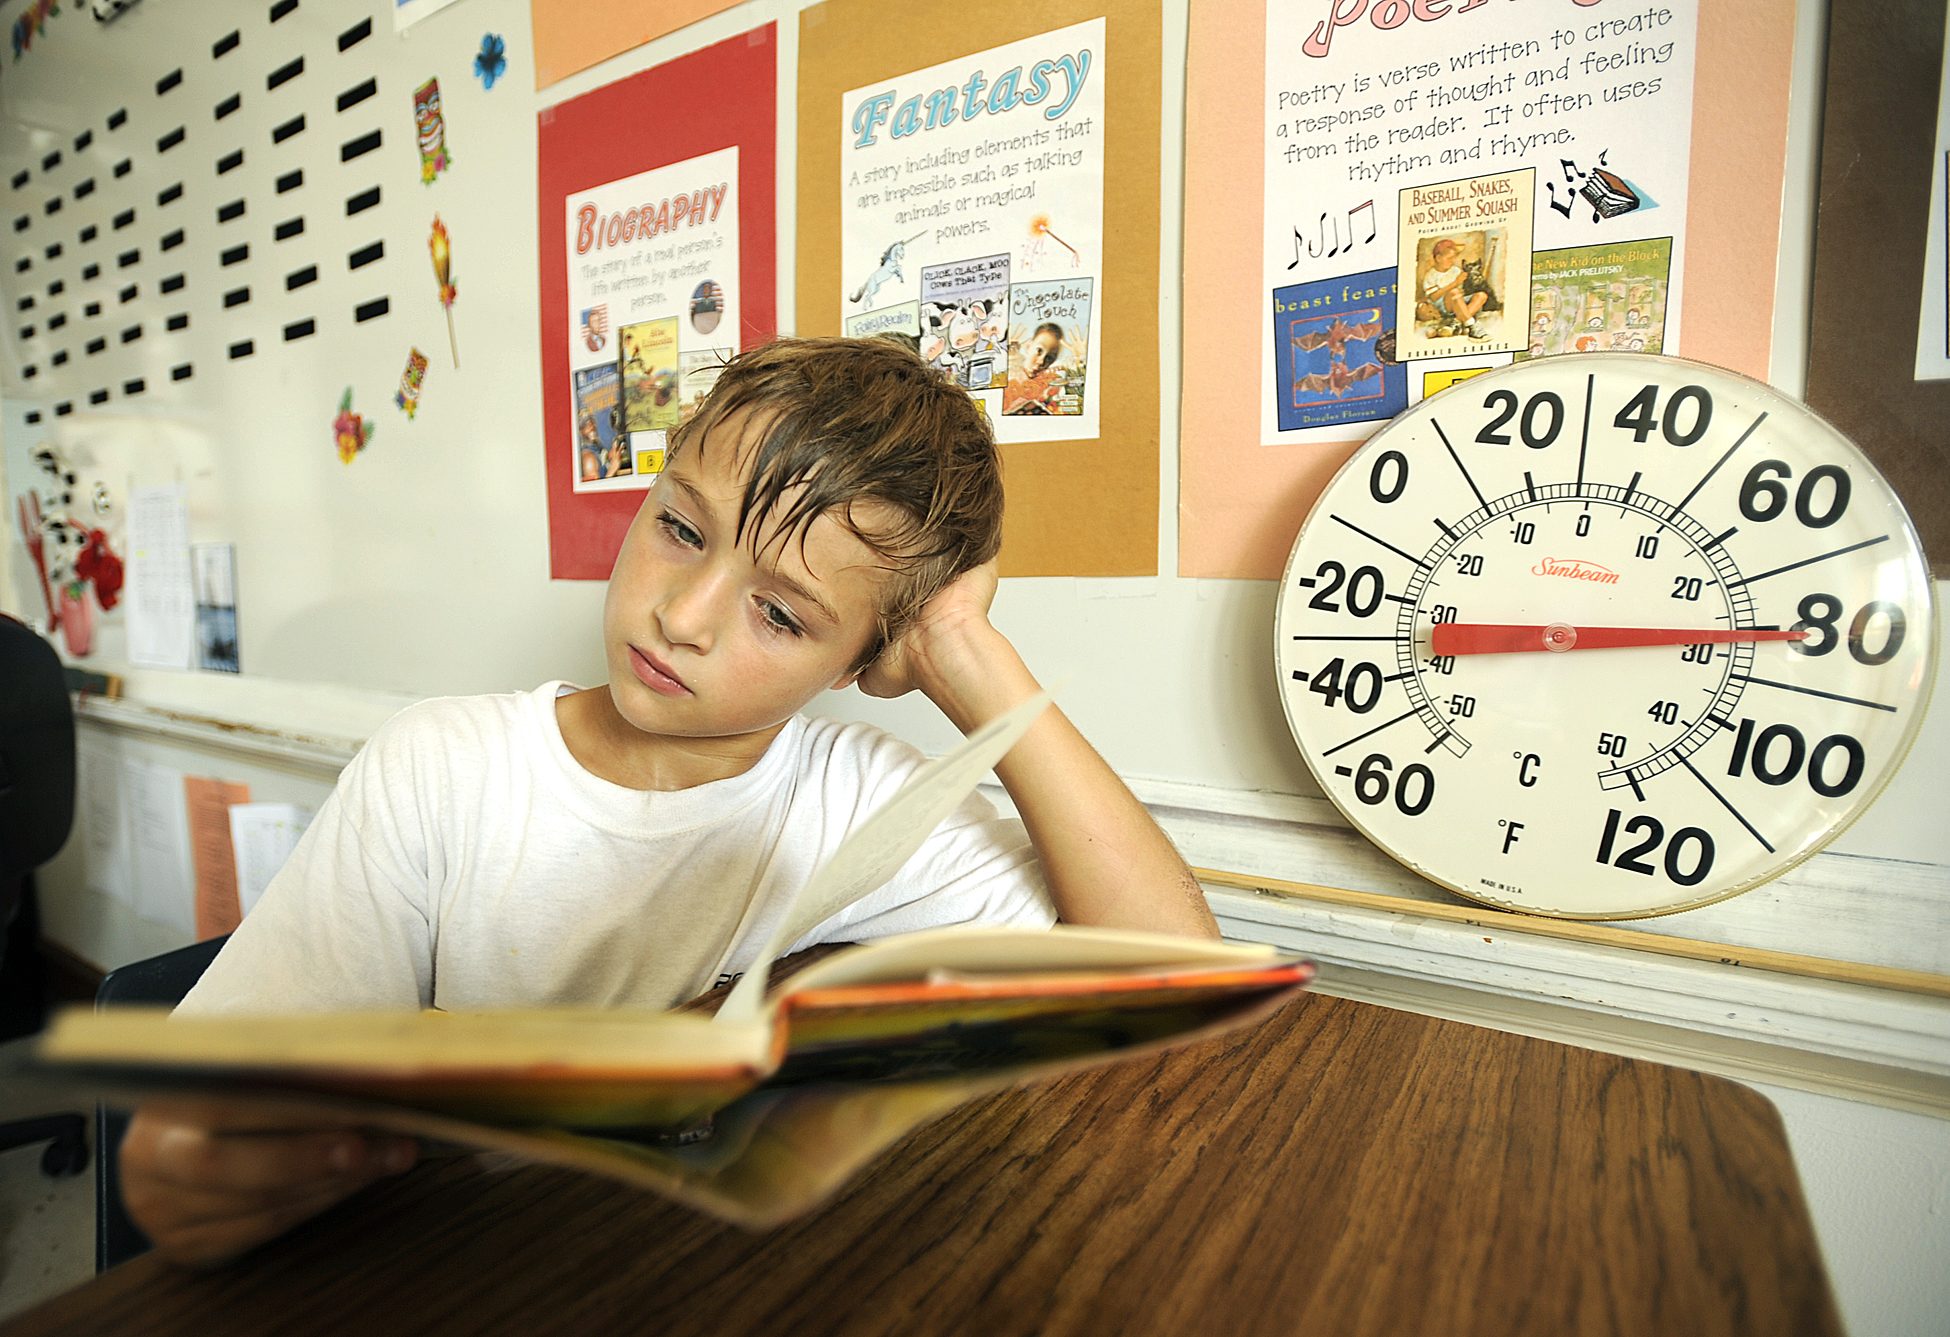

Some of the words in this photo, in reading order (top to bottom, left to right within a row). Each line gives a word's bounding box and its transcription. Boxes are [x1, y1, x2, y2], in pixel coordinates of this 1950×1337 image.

[1278, 83, 1346, 110] Poetry
[1354, 73, 1370, 92] is
[1378, 61, 1441, 87] verse
[1450, 40, 1540, 71] written
[1551, 30, 1575, 50] to
[1585, 8, 1672, 42] create
[852, 49, 1092, 150] Fantasy
[1276, 123, 1288, 138] a
[1295, 103, 1385, 134] response
[1394, 90, 1418, 113] of
[1427, 73, 1516, 107] thought
[1525, 57, 1570, 87] and
[1580, 41, 1674, 74] feeling
[1284, 143, 1337, 163] from
[1345, 133, 1379, 153] the
[1388, 116, 1466, 144] reader.
[1483, 104, 1513, 128] It
[1522, 93, 1592, 118] often
[1603, 77, 1662, 103] uses
[849, 171, 860, 186] A
[864, 165, 902, 185] story
[905, 148, 970, 173] including
[975, 129, 1050, 159] elements
[1055, 117, 1093, 141] that
[1348, 154, 1432, 182] rhythm
[1440, 137, 1482, 164] and
[1491, 128, 1575, 157] rhyme.
[857, 192, 880, 208] are
[884, 173, 957, 202] impossible
[961, 165, 995, 187] such
[1001, 162, 1019, 178] as
[1024, 149, 1083, 172] talking
[895, 200, 951, 224] animals
[955, 197, 971, 212] or
[975, 180, 1037, 208] magical
[935, 219, 991, 244] powers.
[1545, 259, 1568, 270] New
[1570, 255, 1589, 267] Kid
[1591, 256, 1604, 265] on
[1607, 252, 1626, 264] the
[1628, 249, 1660, 262] Block
[1013, 285, 1089, 315] Chocolate
[1032, 303, 1077, 321] Touch
[1274, 294, 1332, 313] beast
[1342, 283, 1397, 302] feast
[1475, 389, 1565, 449] 20
[1613, 385, 1713, 447] 40
[1368, 450, 1408, 504] 0
[1738, 459, 1851, 529] 60
[1510, 522, 1535, 545] -10
[1576, 515, 1591, 537] 0
[1635, 535, 1659, 559] 10
[1457, 554, 1484, 576] -20
[1531, 557, 1620, 585] Sunbeam
[1299, 561, 1384, 618] -20
[1671, 576, 1703, 601] 20
[1431, 605, 1457, 624] -30
[1787, 592, 1907, 666] 80
[1424, 656, 1455, 675] -40
[1681, 644, 1712, 664] 30
[1292, 657, 1383, 714] -40
[1444, 694, 1476, 718] -50
[1648, 700, 1679, 725] 40
[1597, 732, 1627, 758] 50
[1727, 718, 1865, 798] 100
[1334, 753, 1435, 816] -60
[1596, 808, 1715, 886] 120
